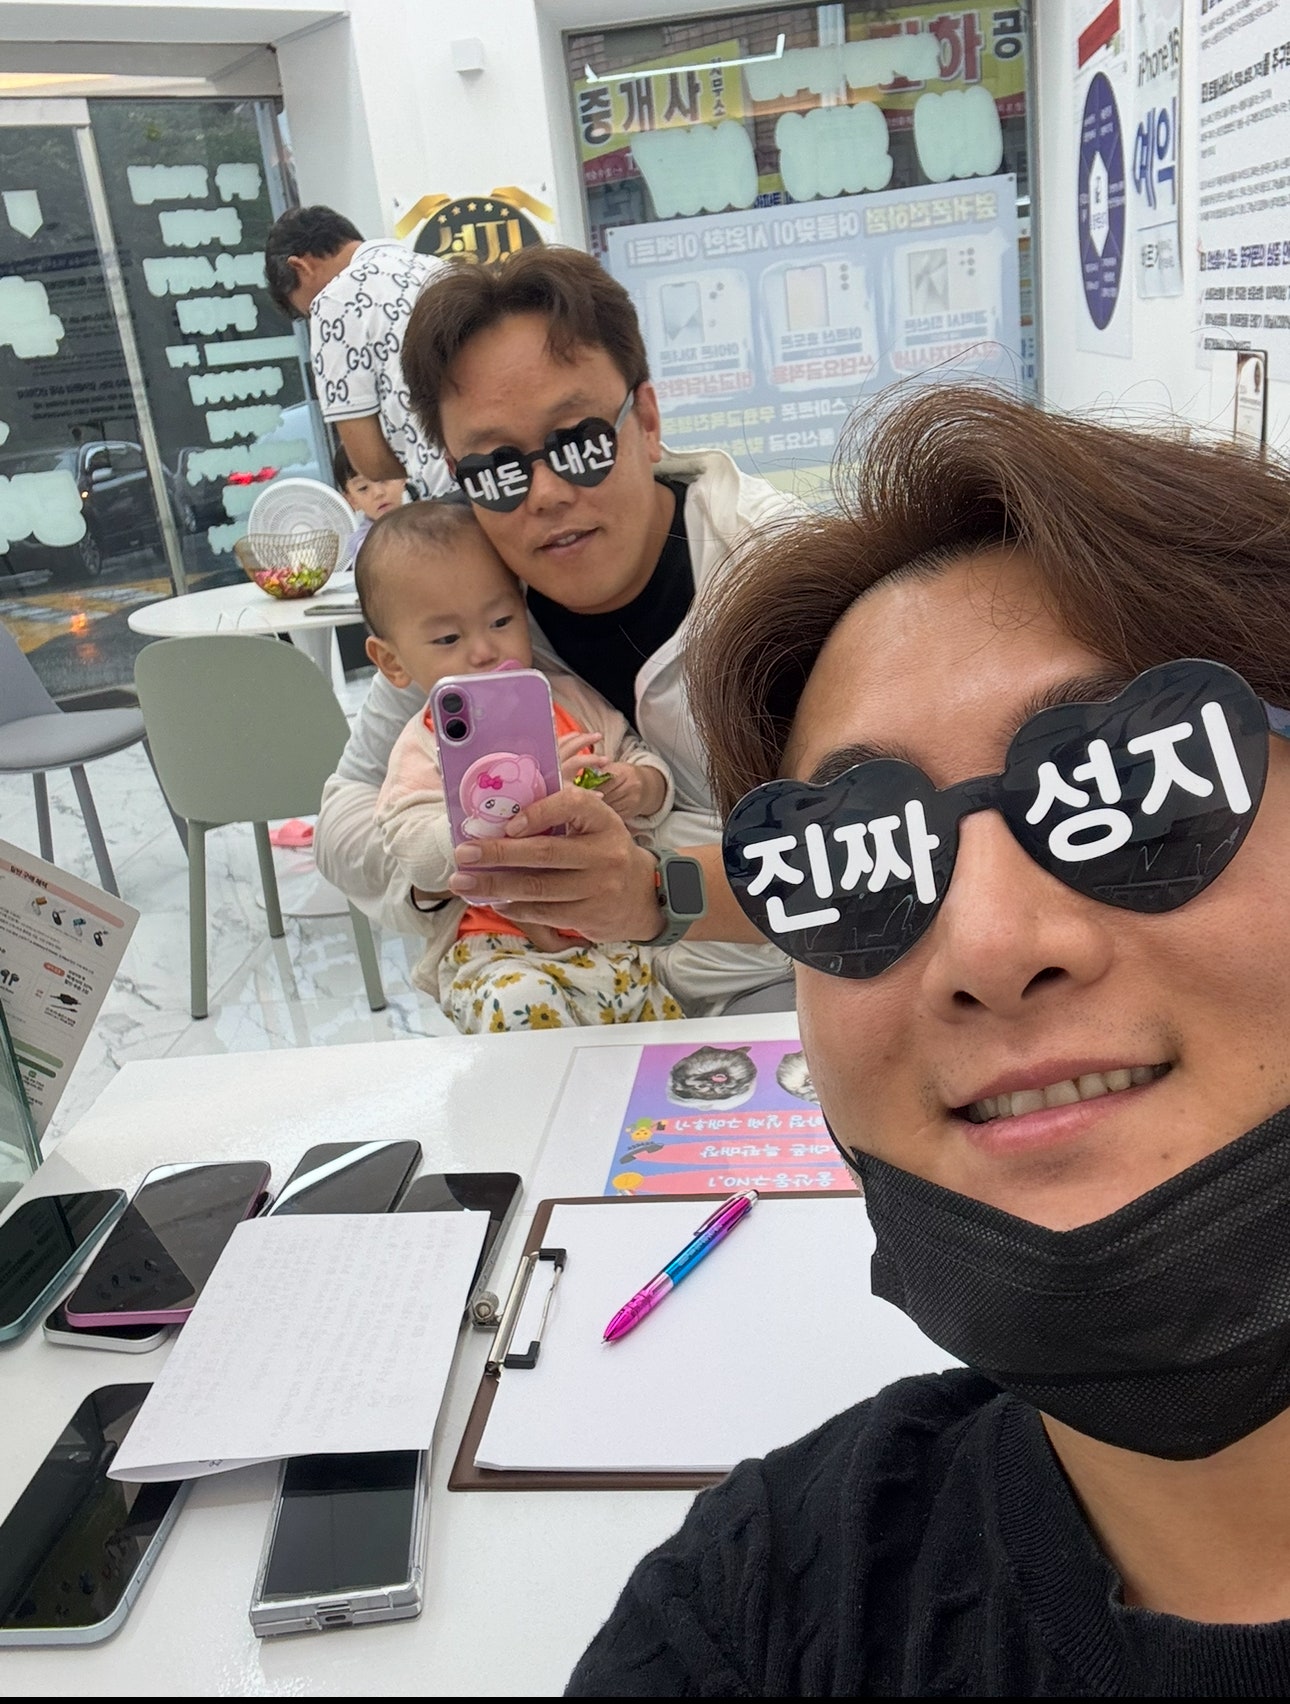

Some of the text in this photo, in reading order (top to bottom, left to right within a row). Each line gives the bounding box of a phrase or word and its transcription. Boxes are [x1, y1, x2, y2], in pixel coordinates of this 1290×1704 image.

[463, 433, 615, 501] 내돈 내산
[742, 701, 1252, 934] 진짜 성지
